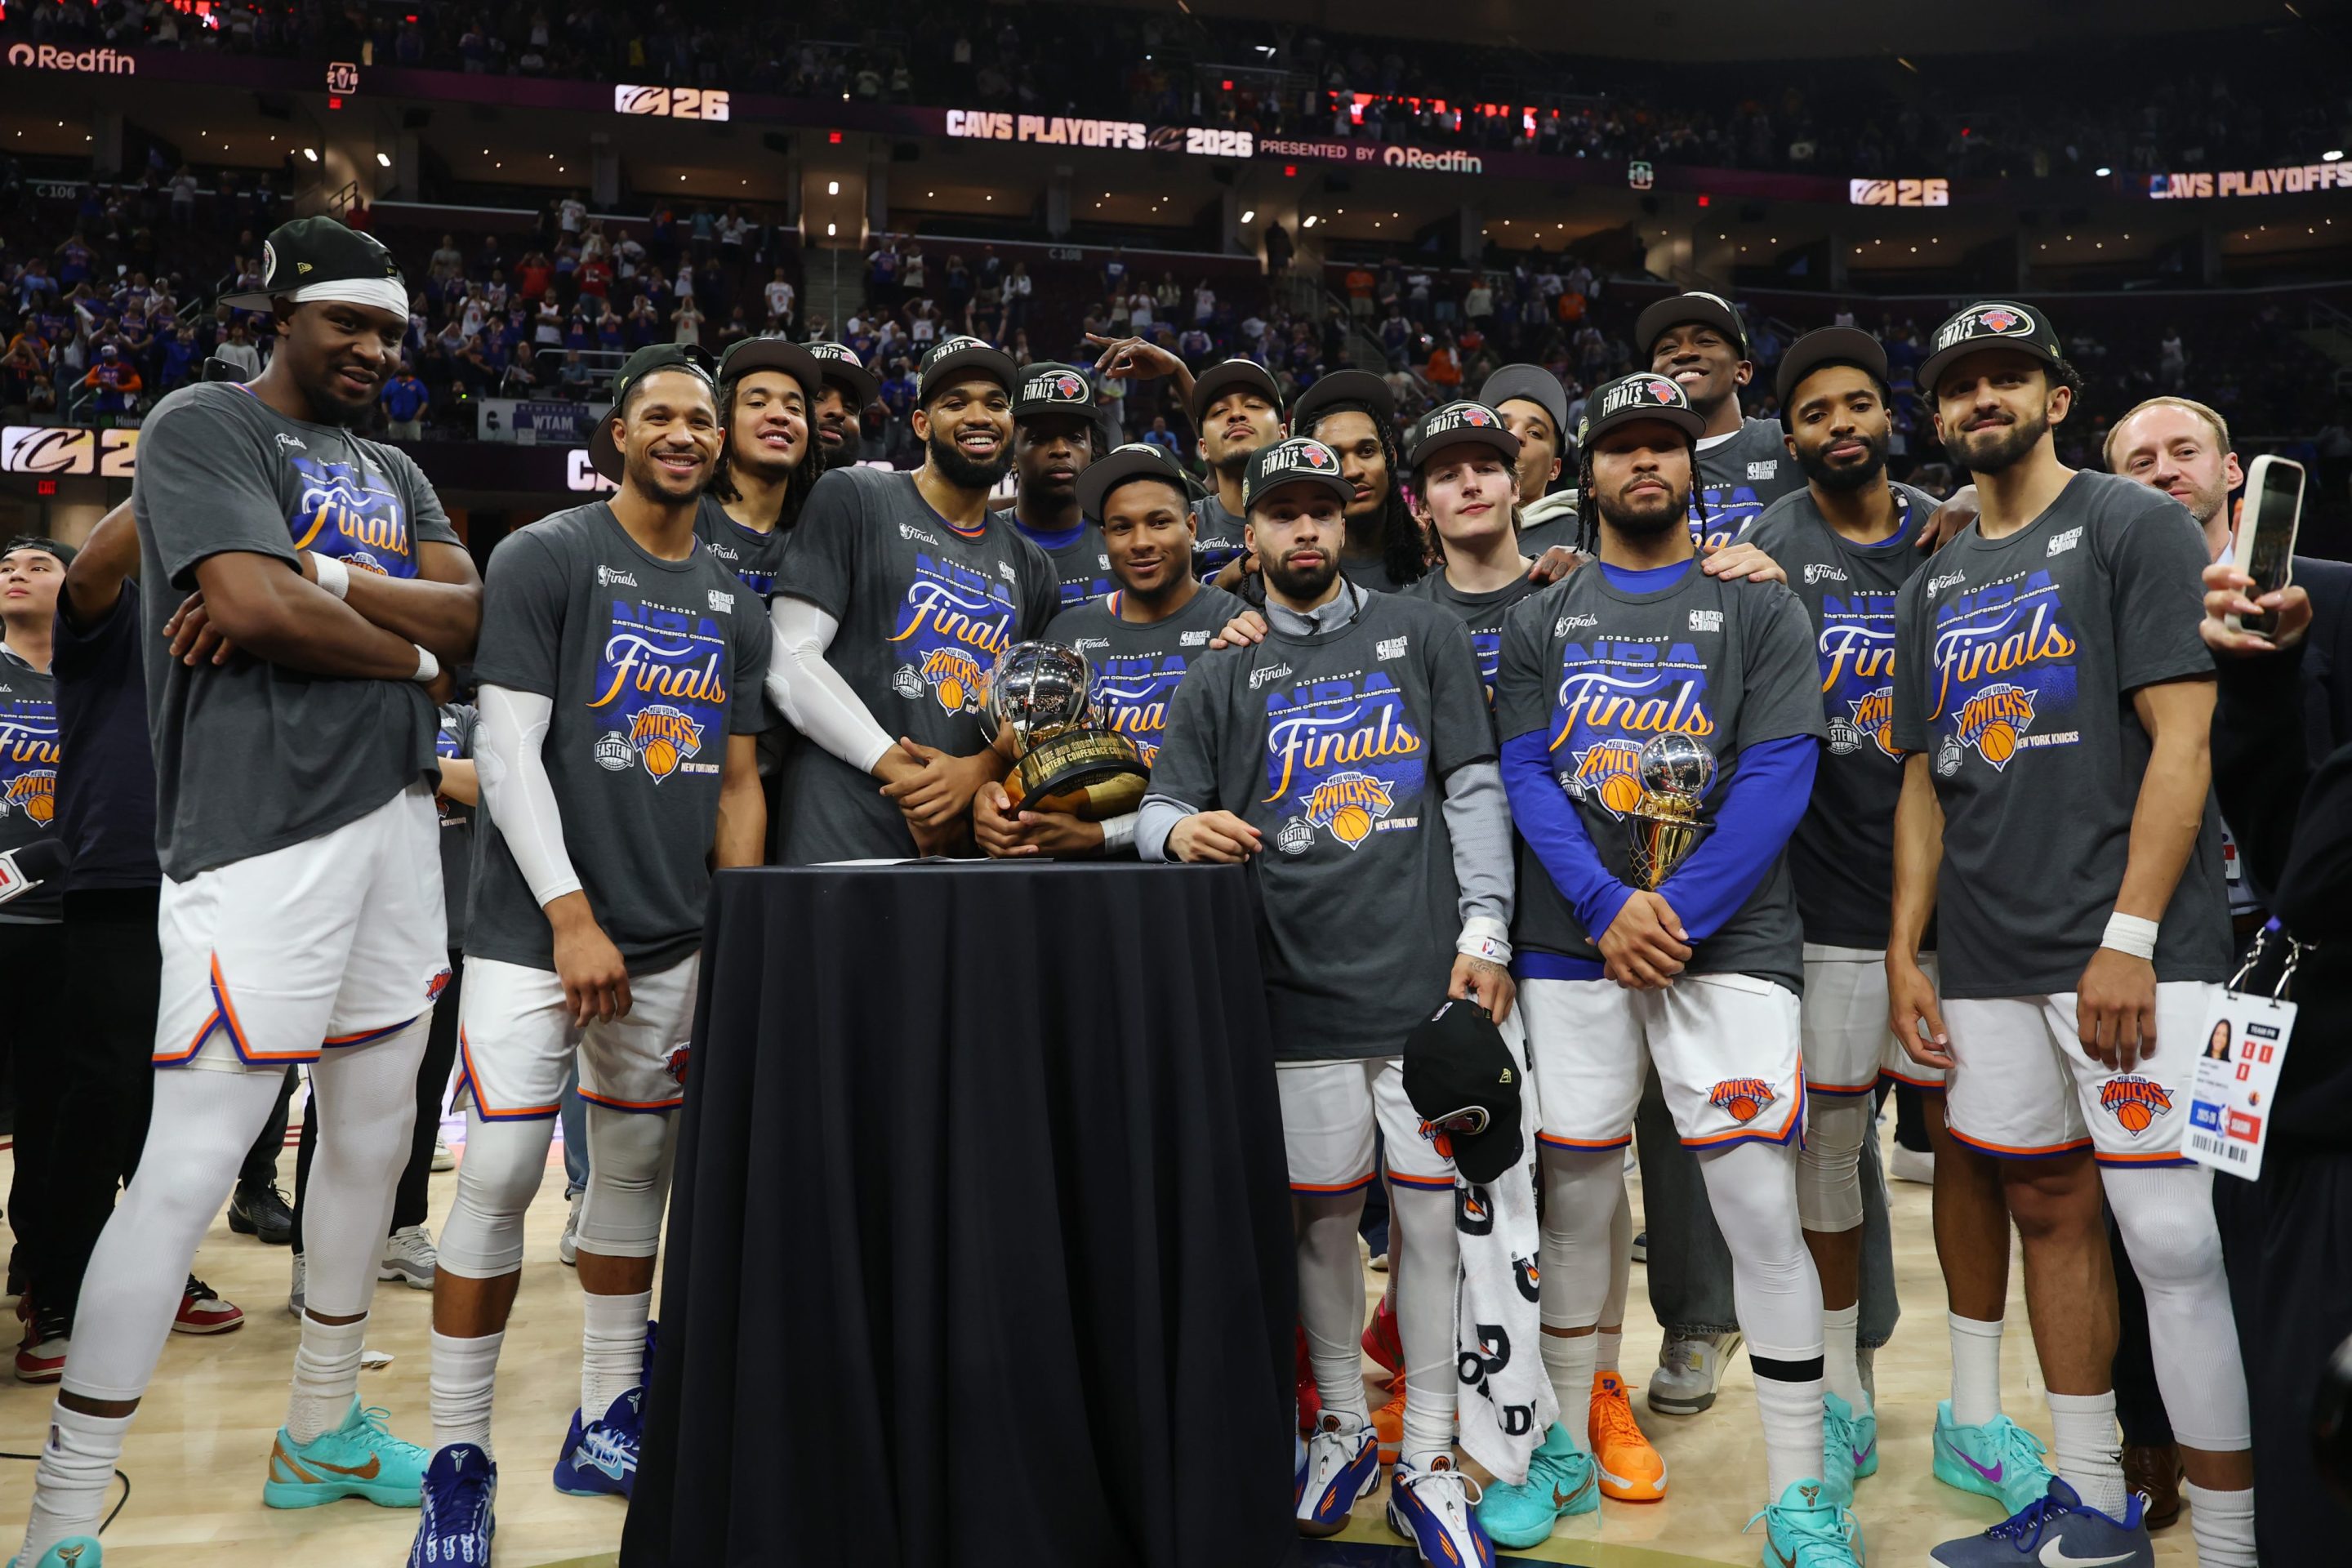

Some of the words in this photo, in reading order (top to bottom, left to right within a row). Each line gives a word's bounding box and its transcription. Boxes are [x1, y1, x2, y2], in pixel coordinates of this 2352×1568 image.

[38, 45, 135, 74] Redfin
[672, 87, 729, 122] 26
[947, 109, 1013, 140] CAVS
[1018, 114, 1147, 150] PLAYOFFS
[1186, 127, 1253, 158] 2026
[1260, 139, 1348, 159] PRESENTED
[1356, 146, 1375, 161] BY
[1406, 148, 1482, 174] Redfin
[2218, 162, 2352, 197] PLAYOFFS
[1898, 178, 1949, 206] 26
[1938, 319, 1976, 351] FINALS
[1022, 381, 1054, 402] FINALS
[1602, 385, 1643, 417] FINALS
[532, 415, 574, 430] WTAM
[1426, 415, 1460, 438] FINALS
[1261, 450, 1299, 479] FINALS
[1759, 460, 1778, 471] LOCKER
[1759, 470, 1775, 479] ROOM
[294, 487, 409, 558] Finals
[904, 525, 939, 546] Finals
[1200, 537, 1230, 552] Finals
[606, 568, 638, 587] Finals
[942, 557, 992, 579] 2025-2026
[1810, 564, 1847, 585] Finals
[916, 568, 945, 581] EASTERN
[946, 578, 984, 596] CONFERENCE
[1939, 569, 1966, 590] Finals
[1963, 571, 2025, 595] 2025-2026
[641, 599, 697, 616] 2025-2026
[1703, 611, 1723, 622] LOCKER
[1936, 616, 1963, 630] EASTERN
[1964, 601, 2012, 618] CONFERENCE
[2013, 583, 2060, 603] CHAMPIONS
[885, 581, 1011, 655] Finals
[1559, 613, 1598, 638] Finals
[1703, 621, 1720, 633] ROOM
[612, 619, 644, 630] EASTERN
[644, 626, 687, 638] CONFERENCE
[689, 634, 725, 645] CHAMPIONS
[1389, 635, 1408, 648] LOCKER
[947, 648, 957, 657] NEW
[957, 651, 972, 662] YORK
[1080, 637, 1110, 653] Finals
[1110, 651, 1163, 660] 2025-2026
[1388, 647, 1406, 659] ROOM
[924, 650, 981, 691] KNICKS
[1563, 659, 1597, 667] EASTERN
[1599, 659, 1655, 668] CONFERENCE
[1819, 626, 1895, 693] Fin
[1927, 603, 2076, 721] Finals
[586, 634, 726, 708] Finals
[1111, 673, 1151, 681] CONFERENCE
[1255, 662, 1293, 689] Finals
[1296, 670, 1361, 688] 2025-2026
[895, 673, 924, 693] EASTERN
[1979, 689, 1991, 699] NEW
[1993, 686, 2011, 694] YORK
[662, 708, 679, 717] YORK
[1267, 705, 1302, 717] EASTERN
[1303, 697, 1353, 710] CONFERENCE
[1355, 688, 1401, 700] CHAMPIONS
[1549, 673, 1714, 752] Finals
[1855, 697, 1892, 725] KNI
[1960, 688, 2031, 737] KNICKS
[631, 711, 701, 749] KNICKS
[1830, 728, 1859, 745] STERN
[2029, 735, 2051, 747] YORK
[2051, 732, 2078, 743] KNICKS
[596, 743, 632, 763] EASTERN
[1067, 746, 1108, 762] CONFERENCE
[1261, 704, 1420, 803] Finals
[1578, 747, 1641, 778] KNIC
[681, 763, 694, 773] NEW
[1329, 775, 1342, 785] NEW
[1343, 773, 1361, 781] YORK
[9, 777, 55, 799] KNIC
[1310, 777, 1392, 820] KNICKS
[1375, 821, 1390, 831] NEW
[1390, 819, 1406, 829] YORK
[1280, 829, 1314, 846] EASTERN
[1709, 1079, 1775, 1104] KNICKS
[2101, 1080, 2172, 1109] KNICKS
